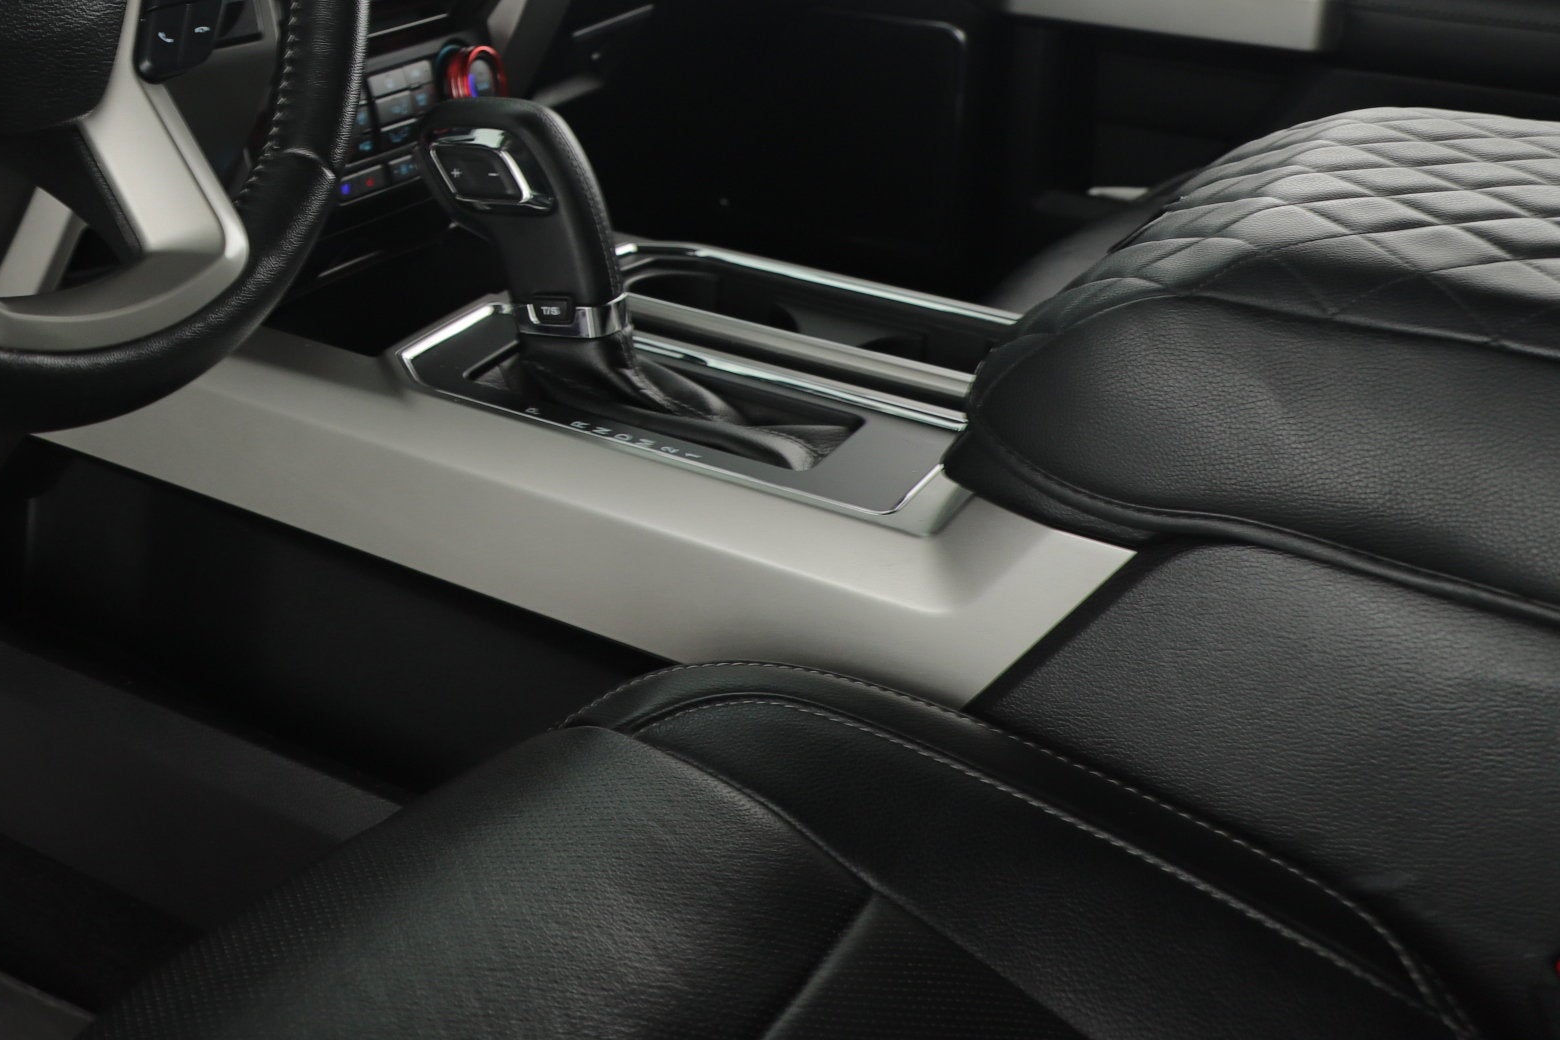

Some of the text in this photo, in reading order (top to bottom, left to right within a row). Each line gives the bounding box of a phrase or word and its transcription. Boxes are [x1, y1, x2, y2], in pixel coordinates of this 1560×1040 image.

[570, 420, 591, 430] R
[592, 426, 612, 435] N
[613, 433, 633, 442] D
[660, 445, 680, 454] 2
